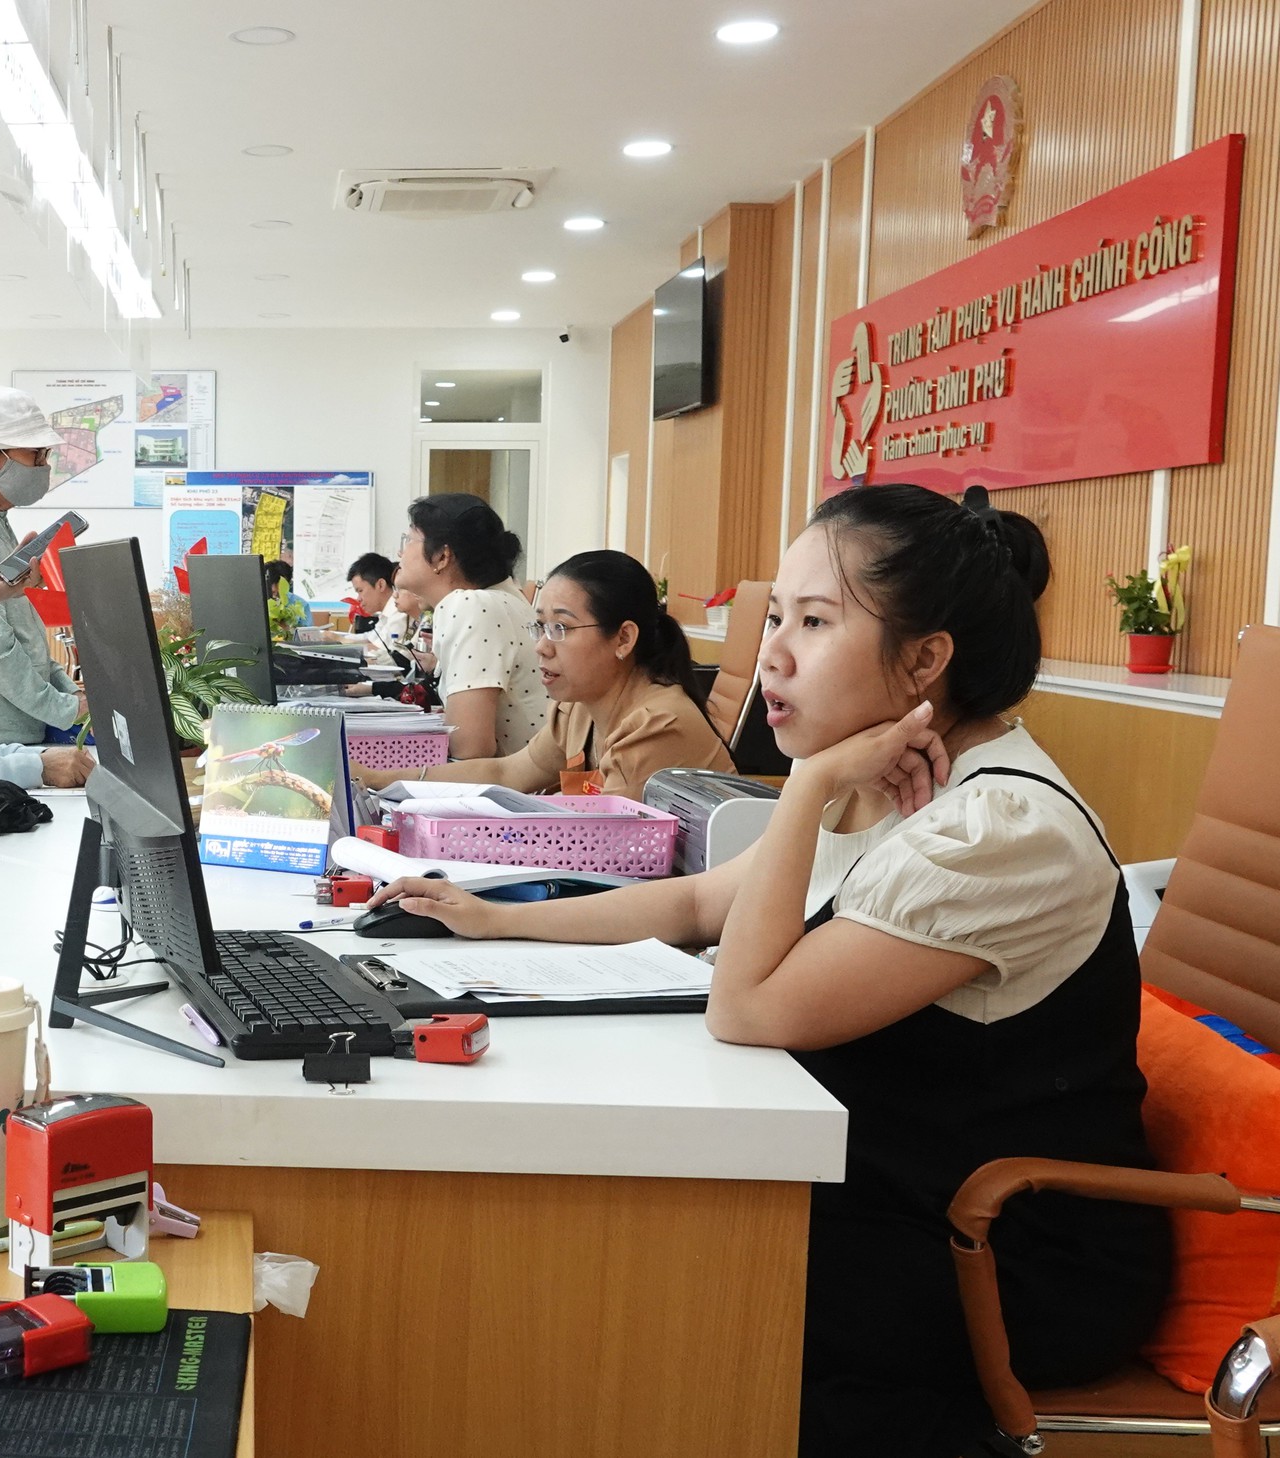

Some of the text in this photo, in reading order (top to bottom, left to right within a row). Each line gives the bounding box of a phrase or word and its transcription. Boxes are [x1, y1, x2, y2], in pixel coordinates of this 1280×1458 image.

[887, 214, 1194, 367] TRUNG TÂM PHỤC VỤ HÀNH CHÍNH CÔNG
[883, 348, 1007, 424] PHƯỜNG BÌNH PHÚ
[882, 421, 986, 462] Hành chính phục vụ
